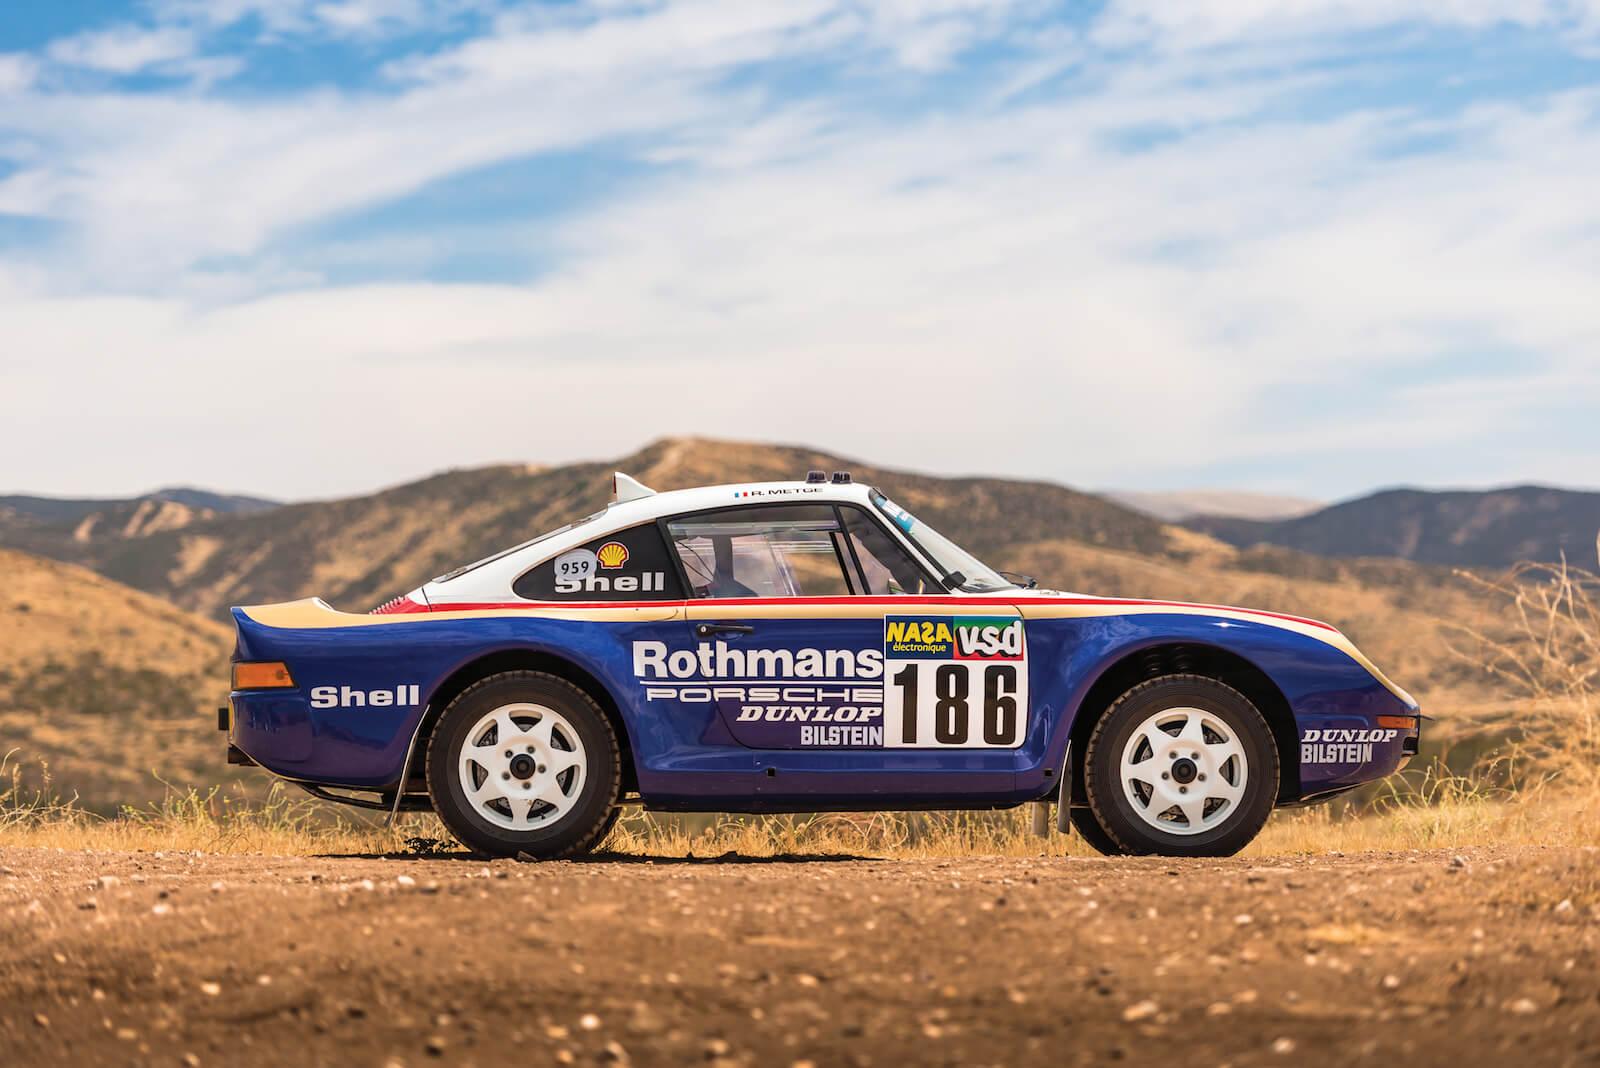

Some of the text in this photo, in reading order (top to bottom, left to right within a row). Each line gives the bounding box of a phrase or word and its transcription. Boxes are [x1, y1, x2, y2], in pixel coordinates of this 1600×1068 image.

[768, 487, 824, 495] METGE
[561, 560, 589, 575] 959
[957, 620, 1022, 656] vsd
[893, 642, 947, 654] électronique
[632, 640, 884, 679] Rothmans
[310, 684, 420, 709] Shell
[646, 687, 884, 703] PORSCHE
[892, 663, 1017, 745] 186
[736, 705, 883, 723] DUNLOP
[800, 725, 884, 747] BILSTEIN
[1301, 729, 1398, 743] DUNLOP
[1301, 743, 1373, 764] BILSTEIN
